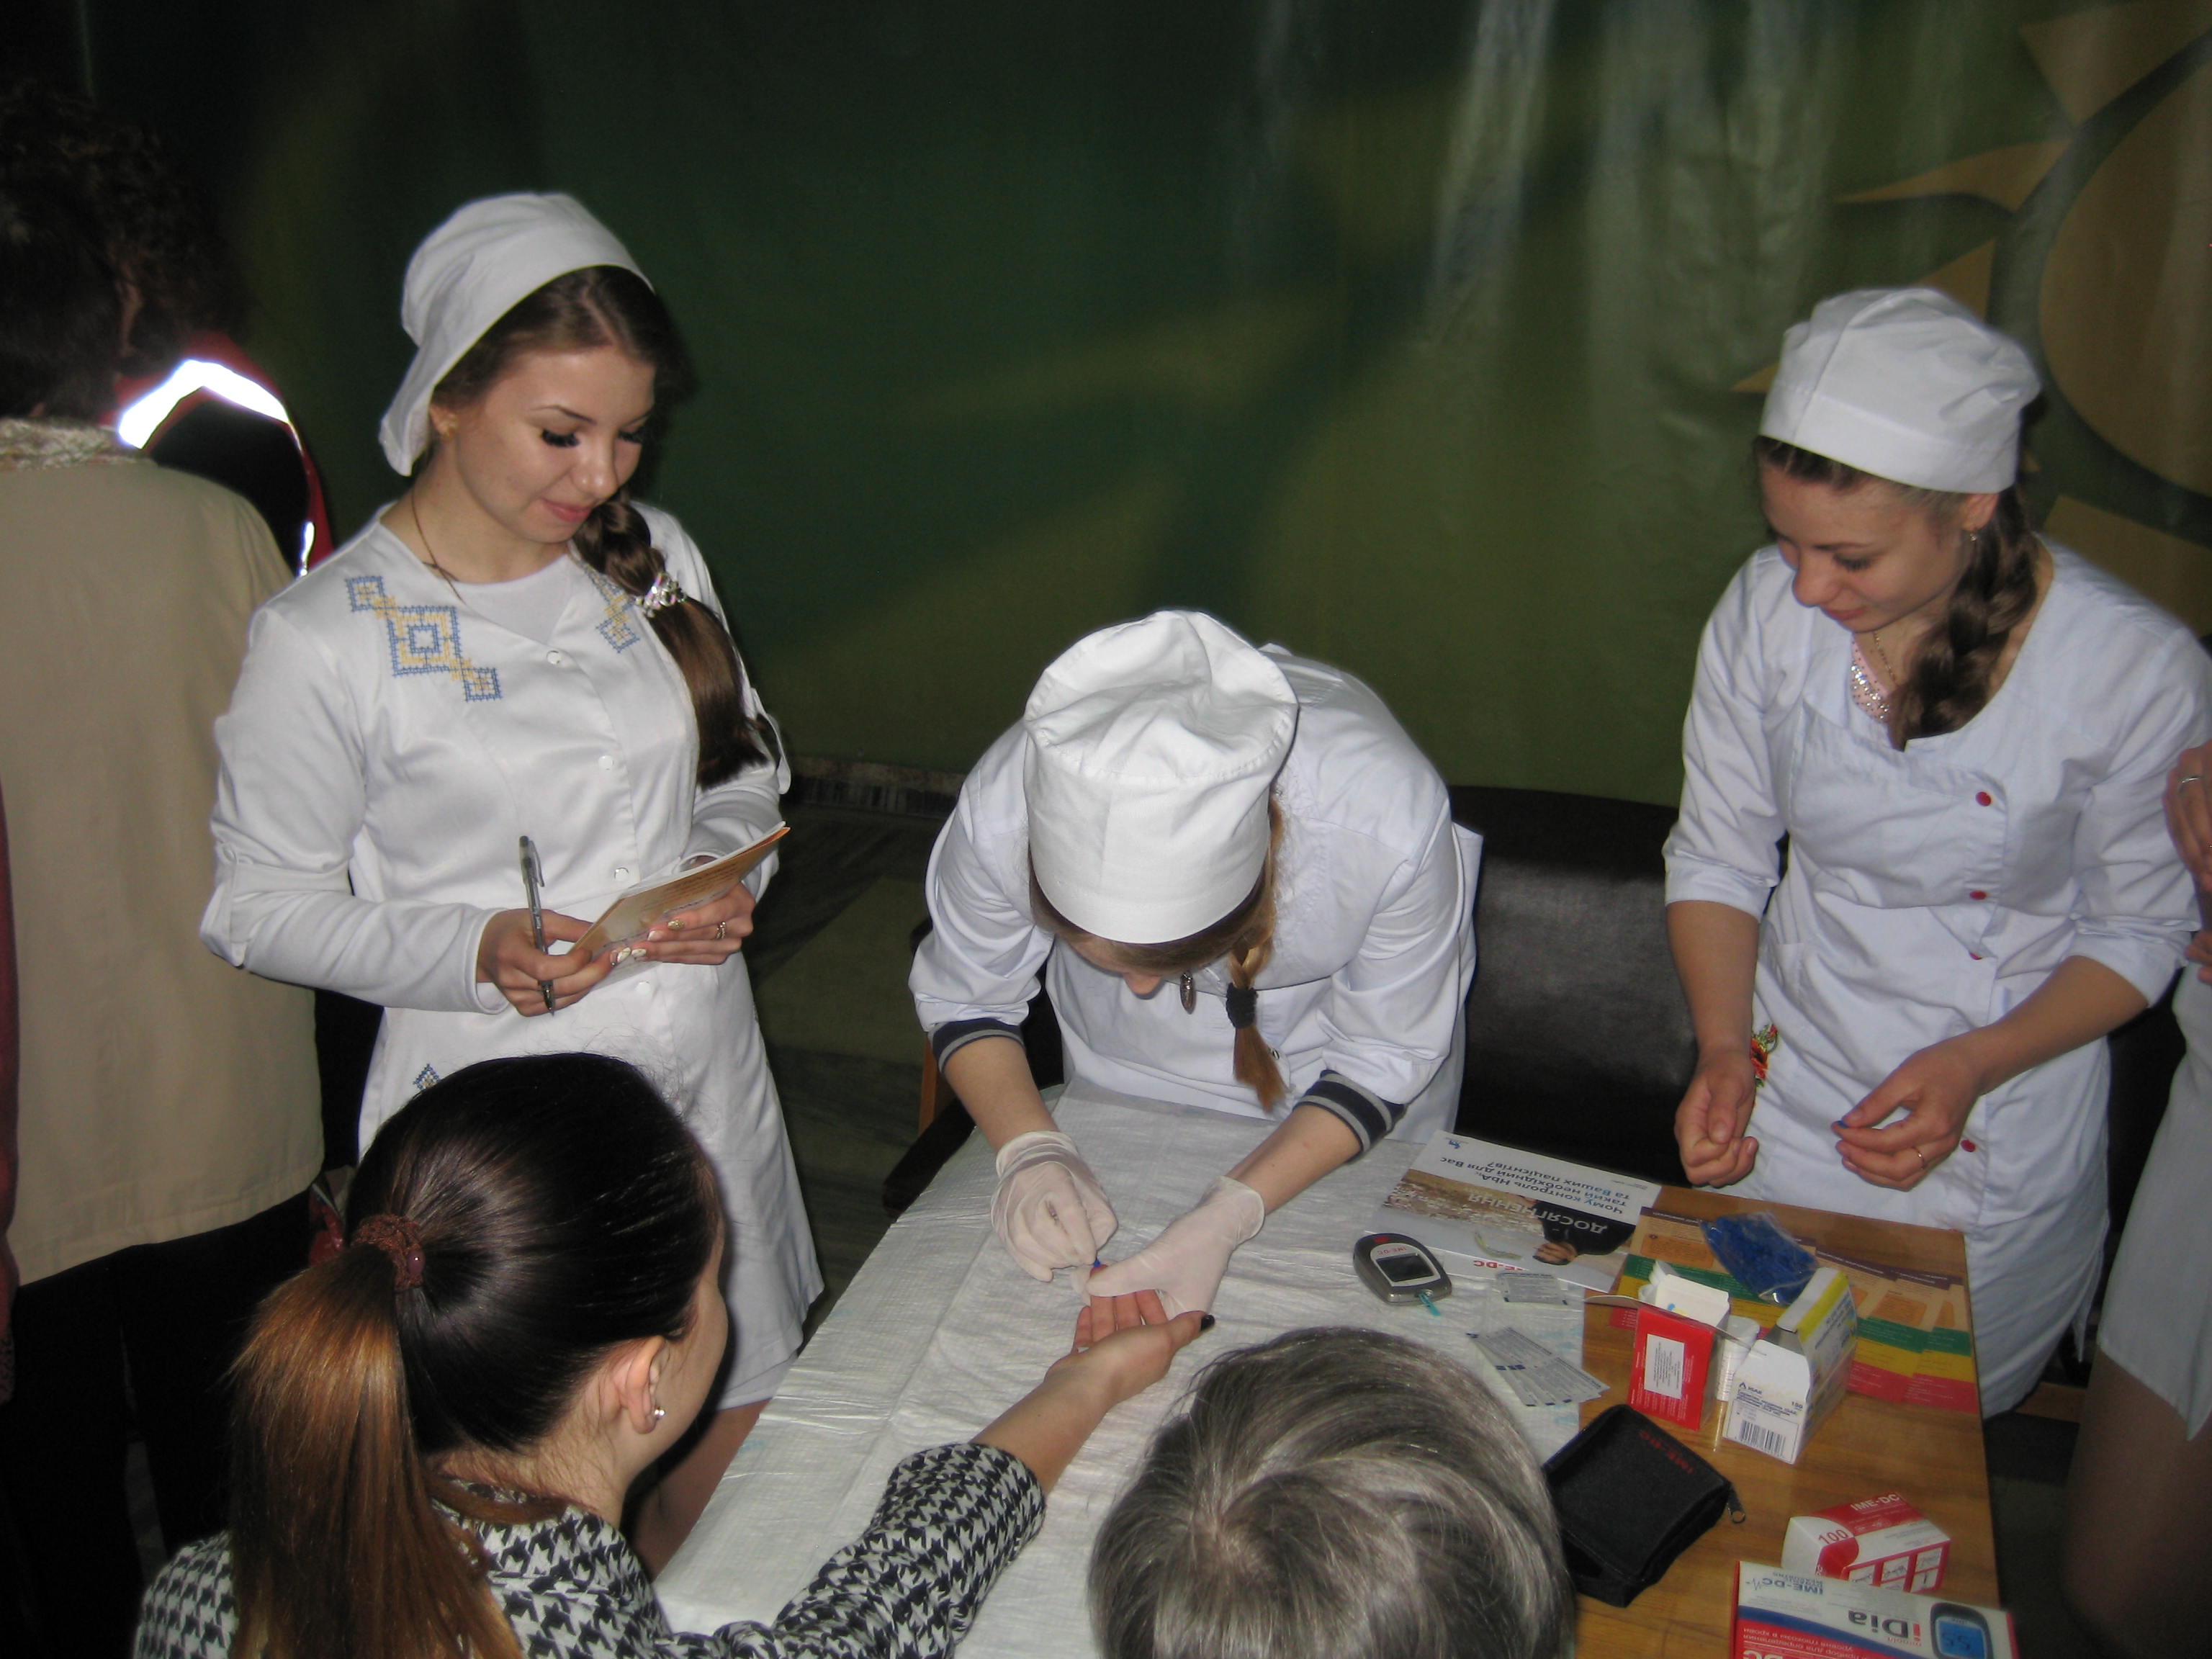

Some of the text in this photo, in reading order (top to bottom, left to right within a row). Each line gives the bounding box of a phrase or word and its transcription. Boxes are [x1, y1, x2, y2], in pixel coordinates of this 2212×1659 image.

[1486, 1161, 1560, 1182] пацієнтів?
[1439, 1156, 1627, 1207] такий необхідний для Вас
[1563, 1179, 1611, 1196] Ваших
[1514, 1182, 1581, 1202] контроль
[1468, 1194, 1607, 1234] ДОСЯГНЕННЯ
[1585, 1199, 1624, 1214] Чому
[1851, 1493, 1900, 1511] IME-DC
[1818, 1528, 1848, 1545] 100
[1762, 1578, 1823, 1595] IME-DC
[1743, 1628, 1770, 1637] крови
[1847, 1610, 1921, 1642] iDia
[1743, 1635, 1803, 1650] определения
[1780, 1635, 1818, 1646] глюкозы
[1806, 1645, 1823, 1653] для
